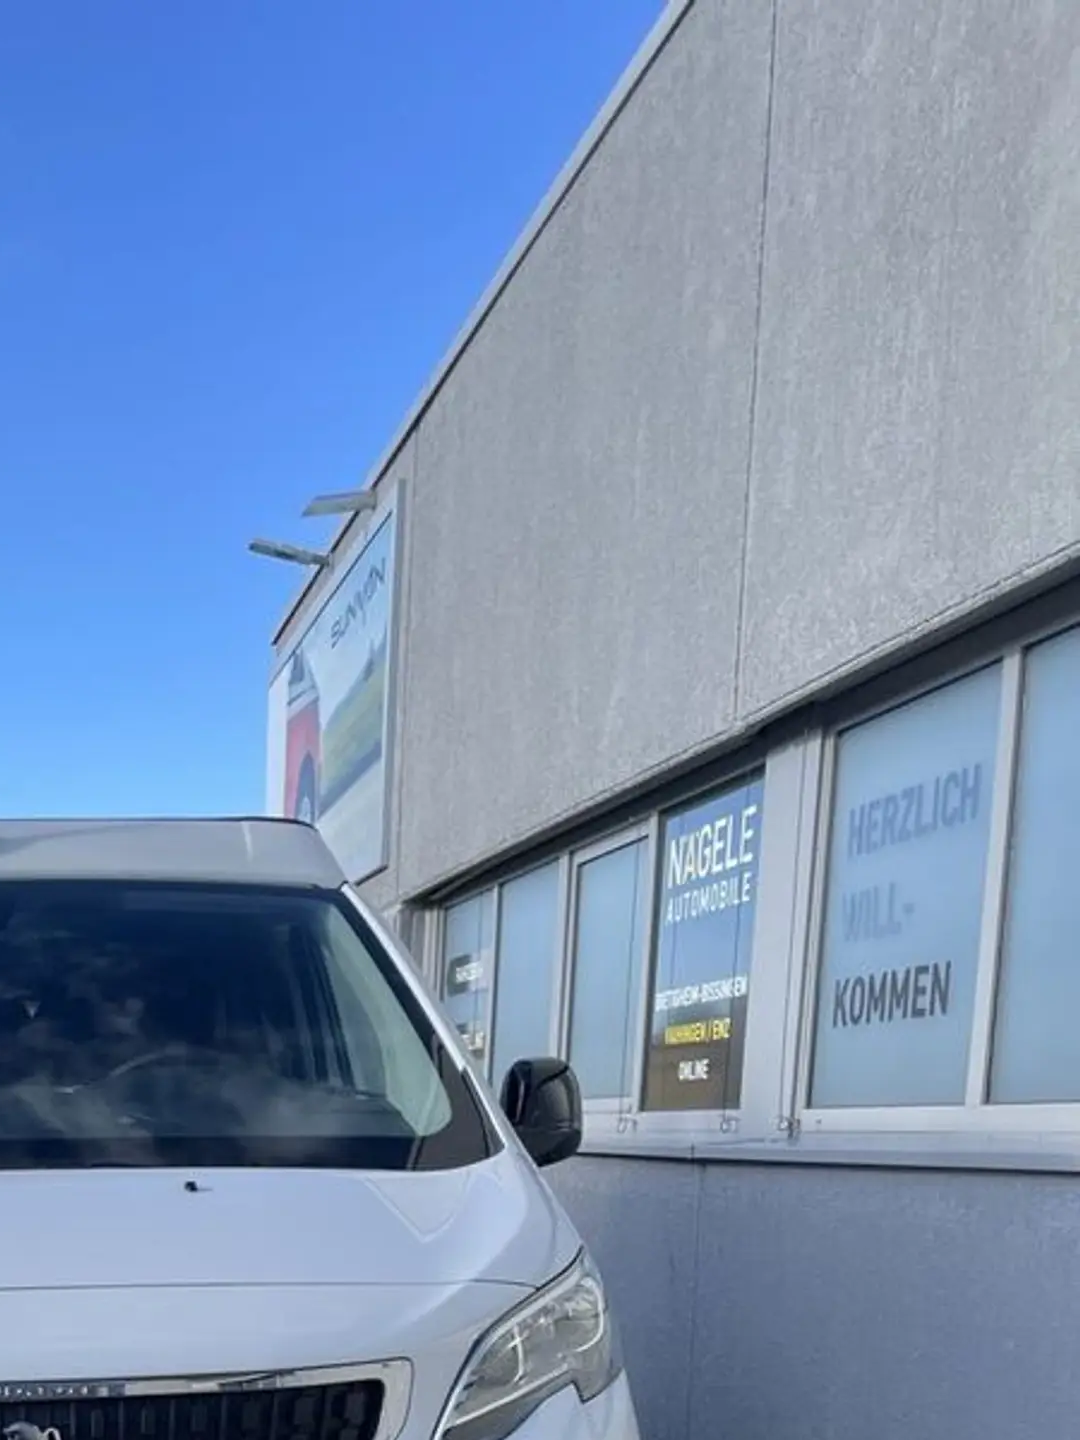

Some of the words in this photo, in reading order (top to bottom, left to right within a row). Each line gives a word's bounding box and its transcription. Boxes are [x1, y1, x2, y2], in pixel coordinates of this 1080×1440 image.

[847, 762, 982, 858] HERZLICH
[667, 804, 757, 889] NÄGELE
[665, 871, 752, 925] AUTOMOBILE
[842, 881, 916, 943] WILL-
[832, 960, 951, 1028] KOMMEN
